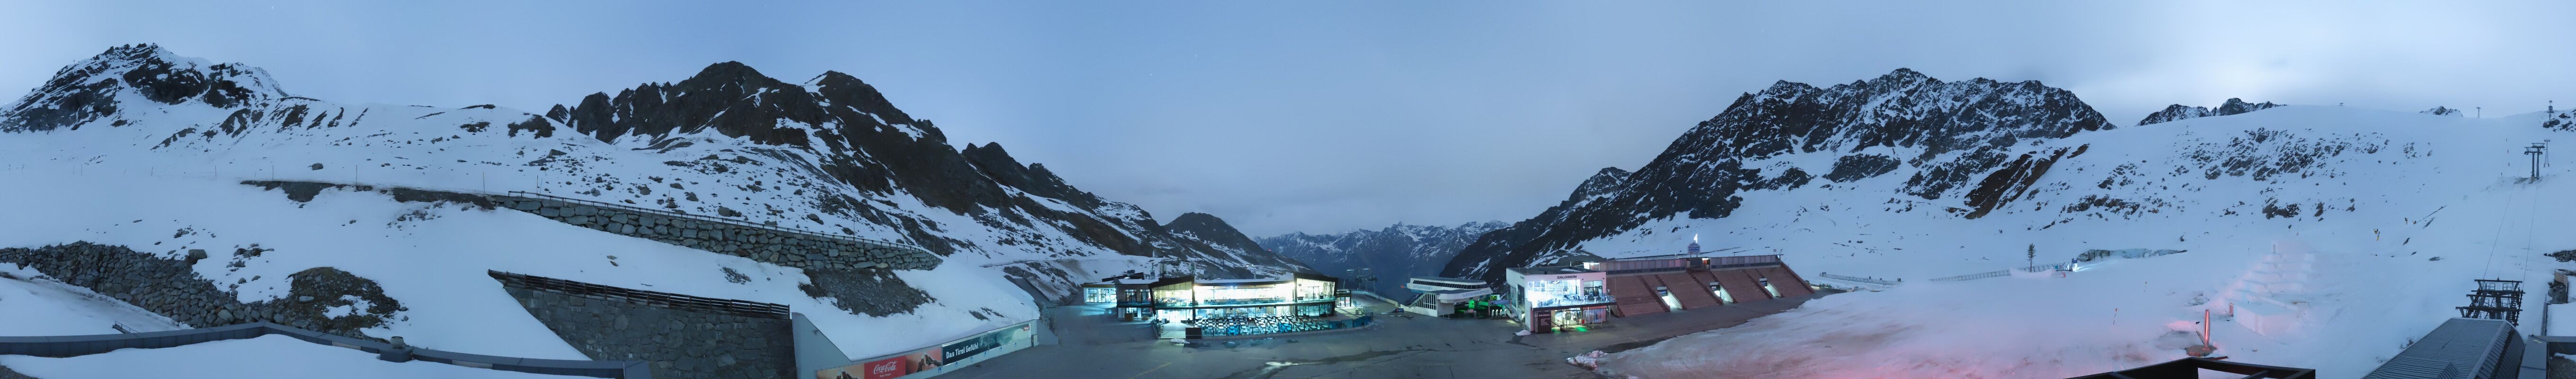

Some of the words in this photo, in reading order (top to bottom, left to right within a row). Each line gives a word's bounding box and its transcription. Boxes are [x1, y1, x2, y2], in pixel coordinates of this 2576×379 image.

[955, 347, 965, 356] Tirol
[966, 343, 979, 352] Gefühl
[874, 360, 898, 374] Coca-Cola
